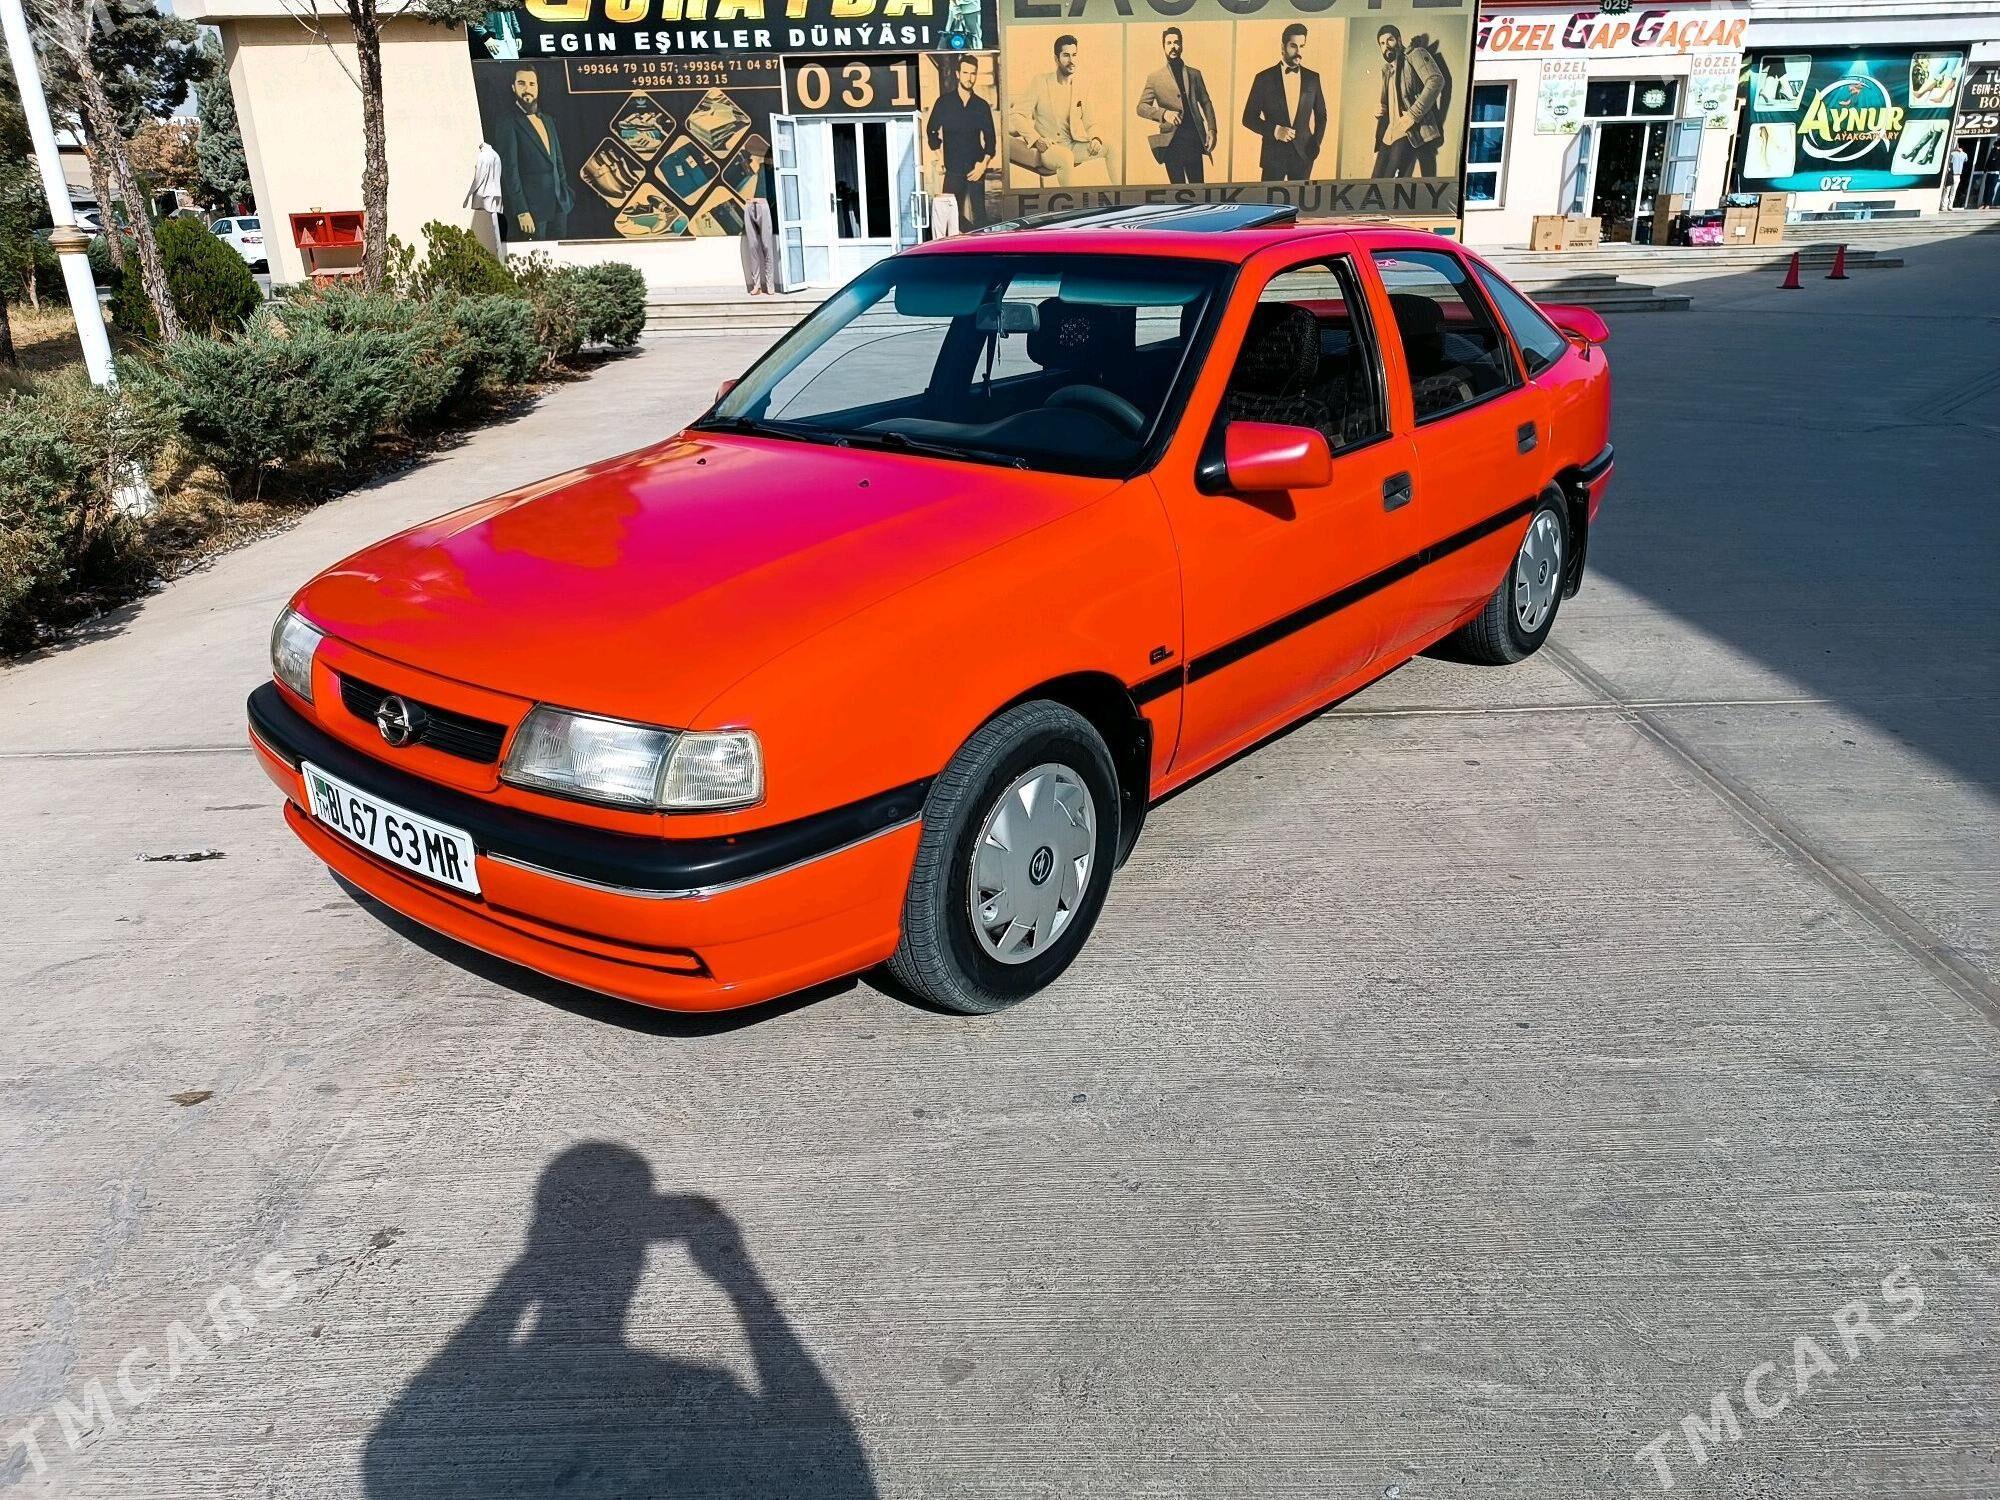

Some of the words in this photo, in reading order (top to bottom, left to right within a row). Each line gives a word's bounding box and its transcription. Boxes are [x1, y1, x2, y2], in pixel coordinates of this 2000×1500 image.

[540, 32, 616, 52] EGIN
[634, 29, 772, 54] EŞIKLER
[788, 22, 930, 47] DÜNÝÄSI
[1562, 12, 1630, 49] GAP
[1631, 10, 1746, 54] GAÇLAR
[577, 64, 619, 74] +99364
[624, 63, 637, 74] 79
[643, 63, 656, 73] 10
[682, 61, 724, 72] +99364
[729, 60, 742, 71] 71
[747, 60, 761, 70] 04
[765, 59, 779, 69] 87
[631, 75, 673, 86] +99364
[678, 74, 691, 85] 33
[696, 74, 710, 85] 32
[715, 74, 728, 84] 15
[796, 60, 916, 110] 031
[1971, 83, 2000, 96] EGIN-E
[1979, 96, 2000, 108] BO
[1797, 88, 1904, 141] AYNUR
[1820, 175, 1852, 191] 027
[1266, 180, 1450, 212] DÜKANY
[317, 797, 331, 820] TM
